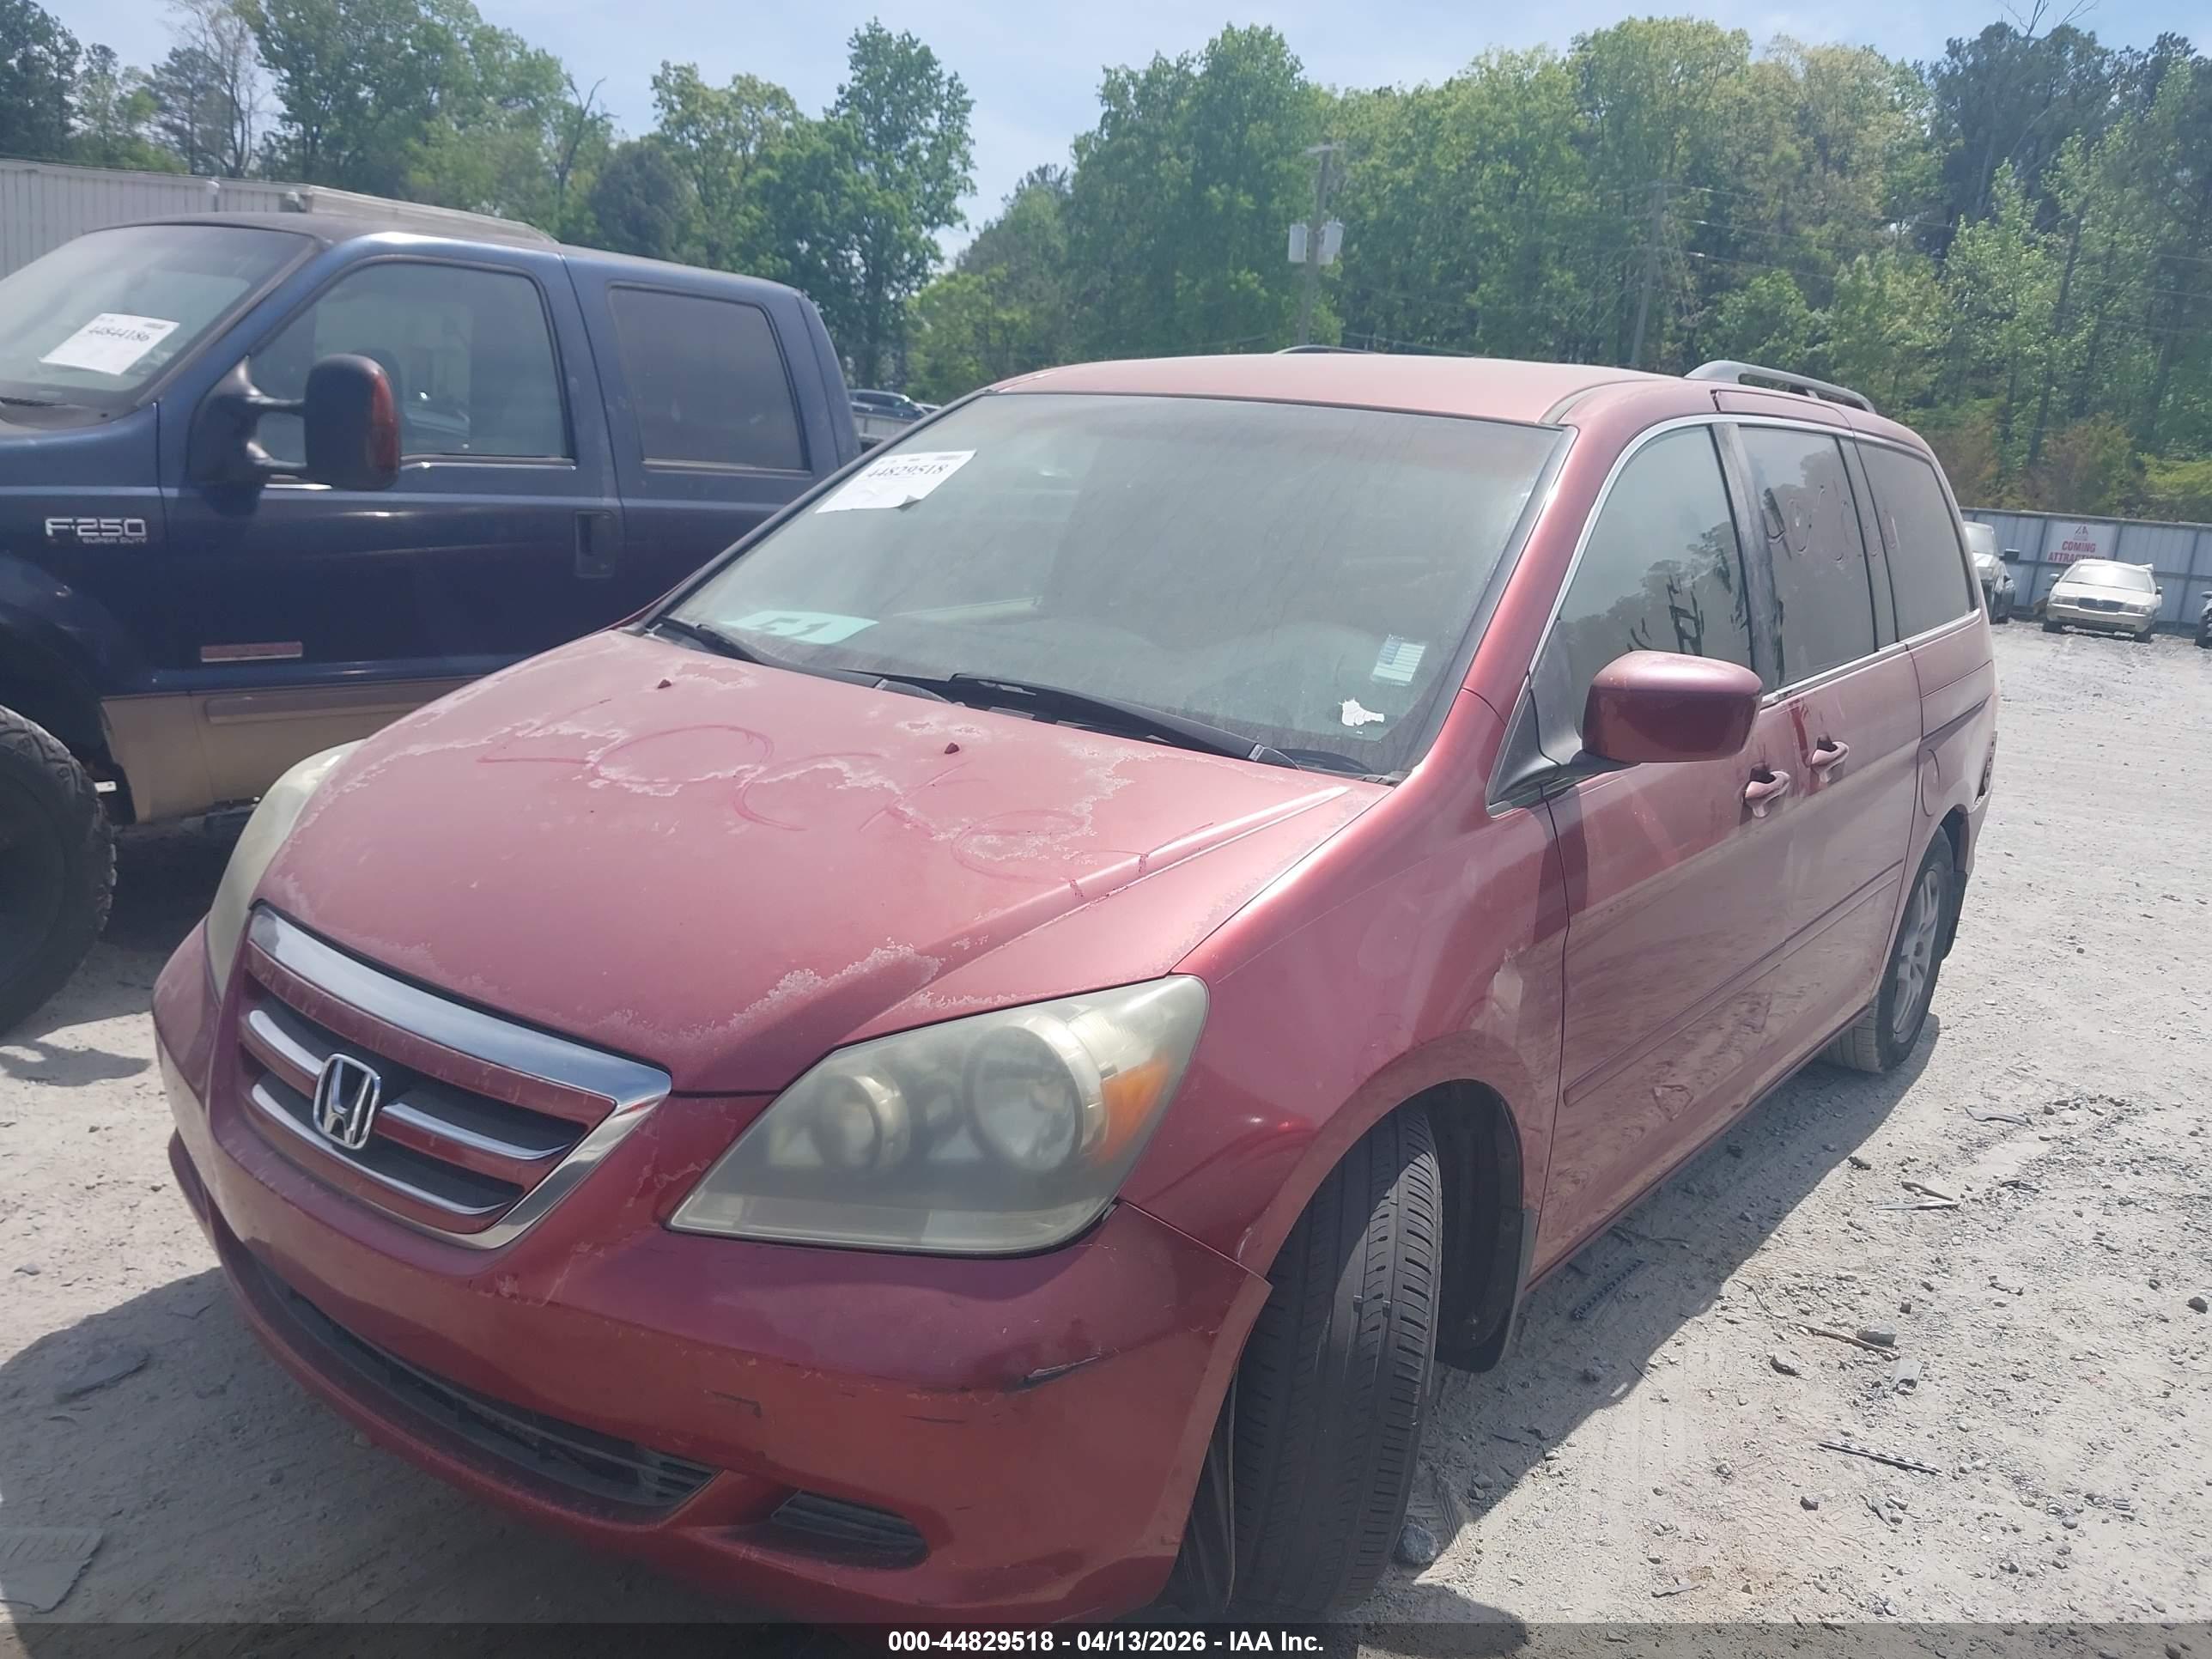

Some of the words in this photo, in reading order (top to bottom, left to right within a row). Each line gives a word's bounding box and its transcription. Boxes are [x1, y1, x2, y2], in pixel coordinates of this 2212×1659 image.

[866, 464, 950, 478] 44829518
[2061, 540, 2097, 553] COMING
[2047, 551, 2106, 564] ATTRAC
